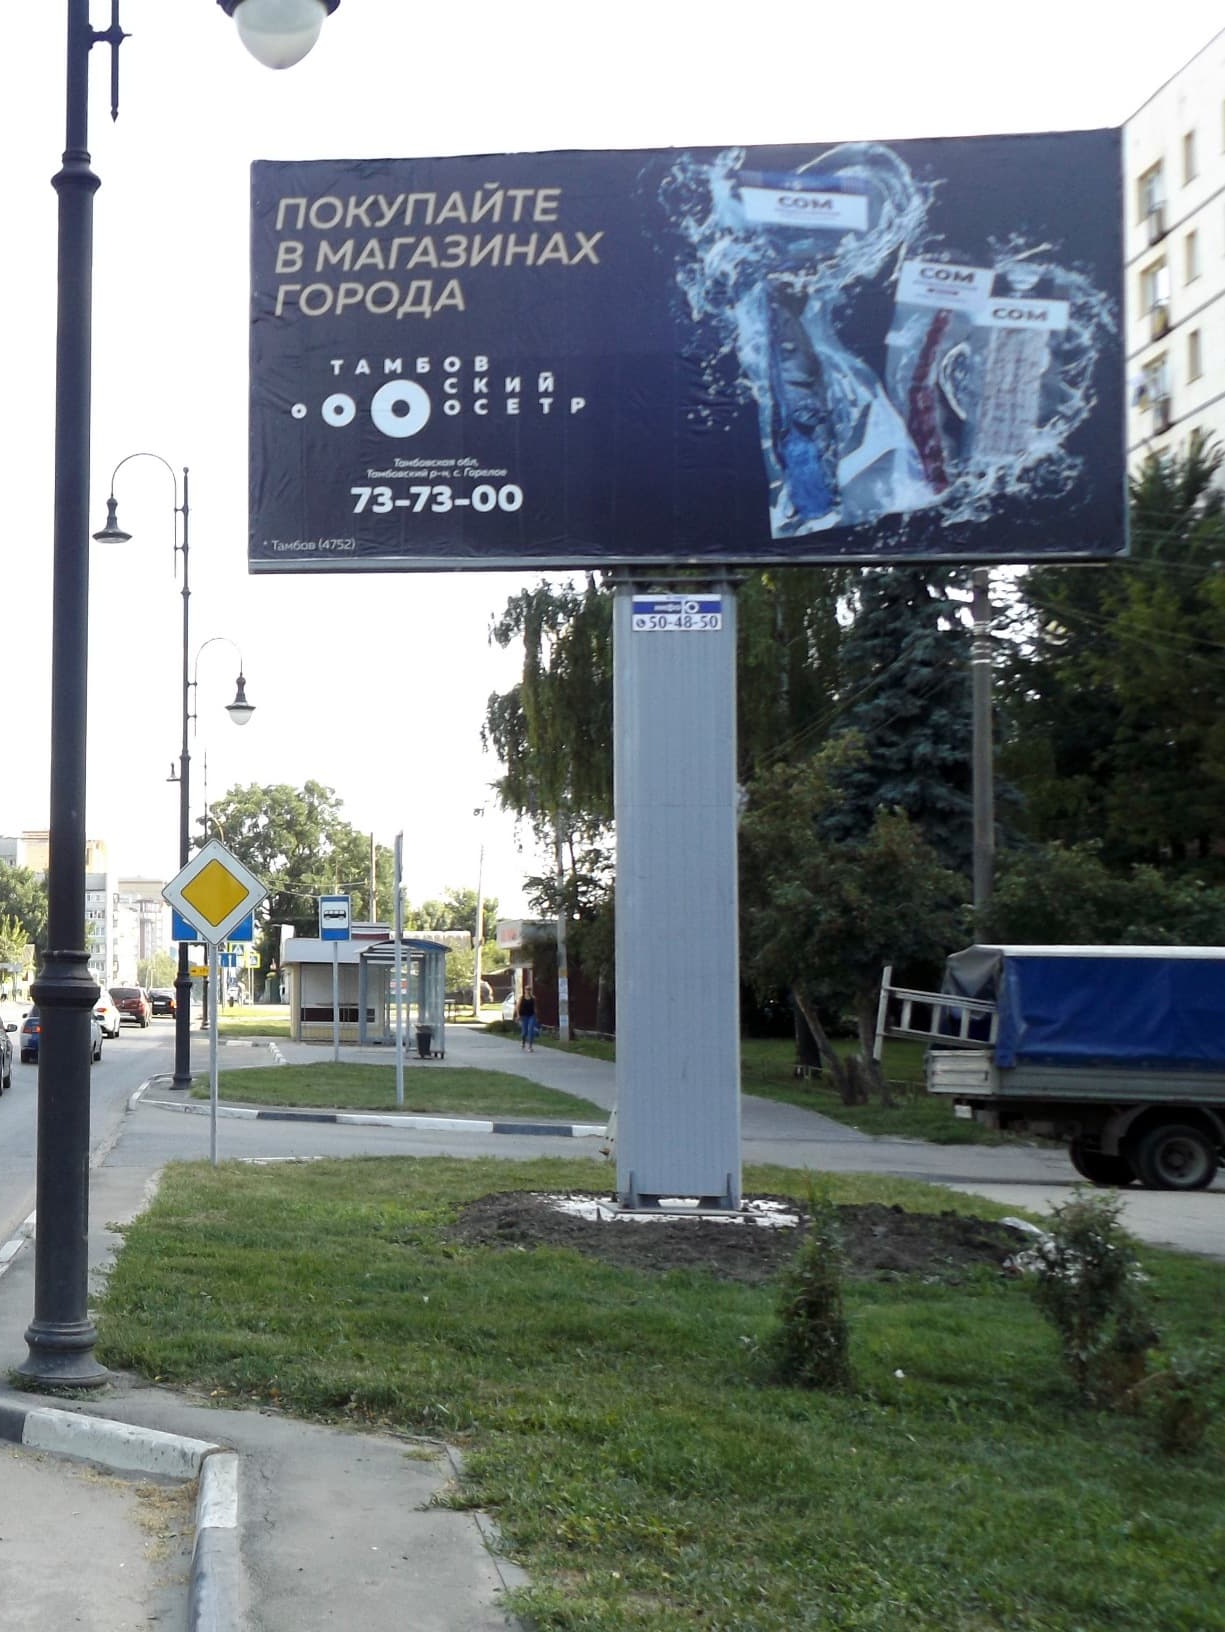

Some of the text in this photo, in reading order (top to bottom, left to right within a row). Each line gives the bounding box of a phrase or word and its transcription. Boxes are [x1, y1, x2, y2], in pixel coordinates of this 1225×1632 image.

[275, 181, 562, 231] ПОКУПАЙТЕ
[275, 231, 605, 274] В МАГАЗИНАХ
[920, 267, 975, 284] СОМ
[275, 278, 466, 320] ГОРОДА
[992, 307, 1048, 322] СОМ
[330, 355, 490, 376] ТАМБОВ
[443, 371, 554, 394] СКИЙ
[443, 397, 586, 416] ОСЕТР
[366, 468, 427, 479] Тамбовский
[349, 484, 524, 514] 73-73-00
[271, 537, 356, 552] Тамбов (4752)
[649, 615, 718, 629] 50-48-50
